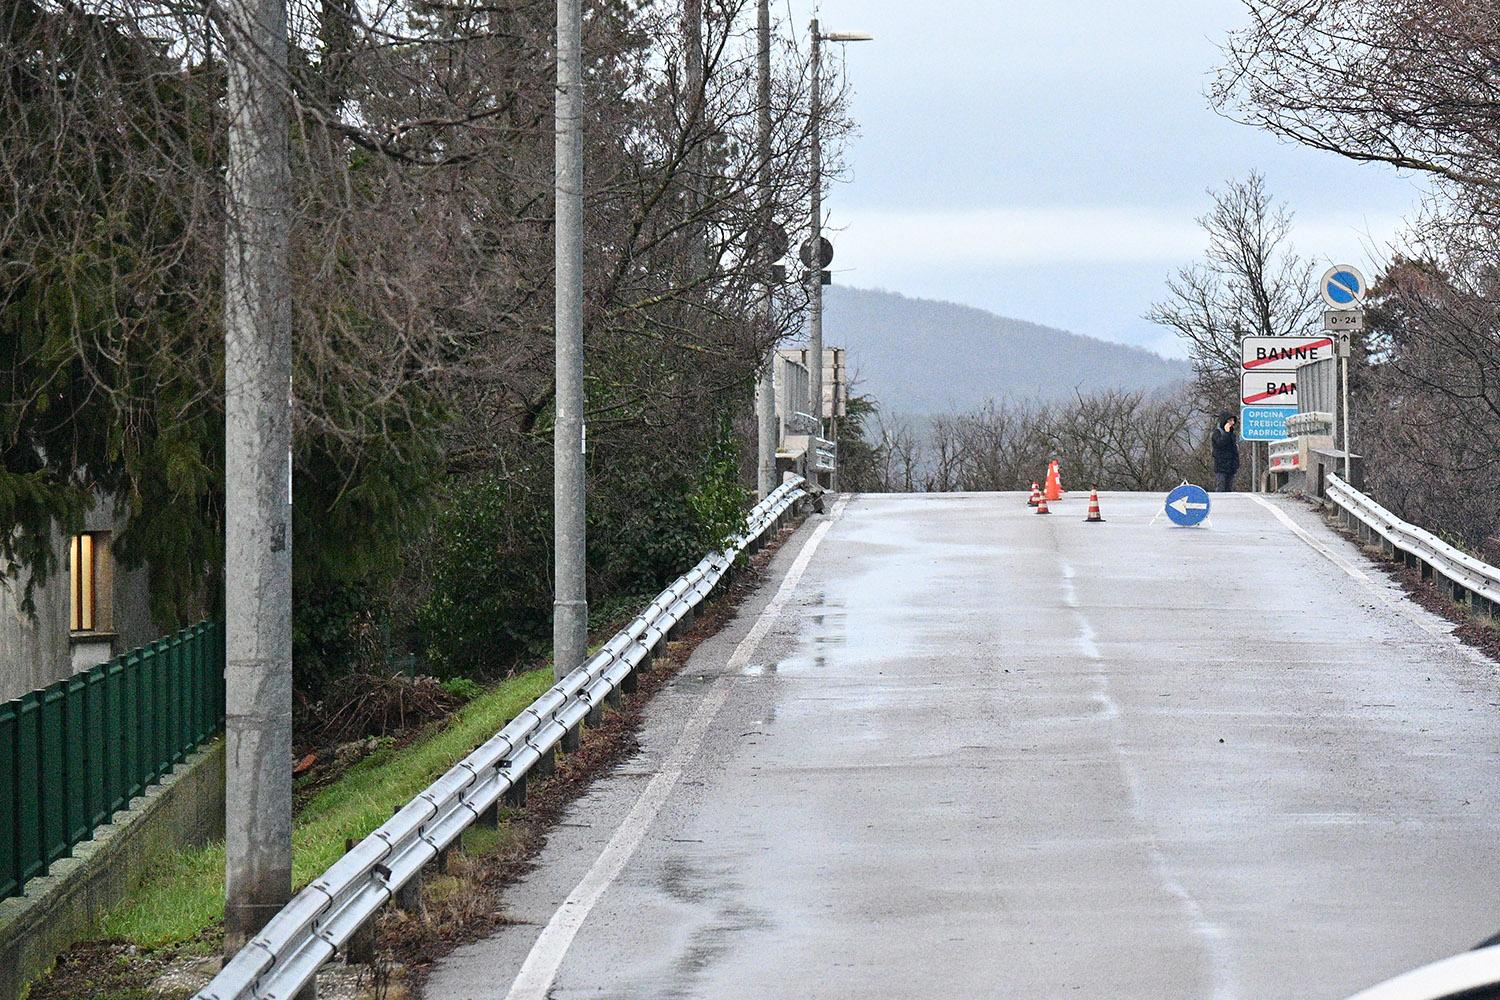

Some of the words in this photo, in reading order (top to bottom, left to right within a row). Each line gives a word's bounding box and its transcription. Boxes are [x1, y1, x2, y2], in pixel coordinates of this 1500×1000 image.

[1331, 316, 1338, 324] 0
[1345, 316, 1356, 324] 24
[1256, 347, 1318, 360] BANNE
